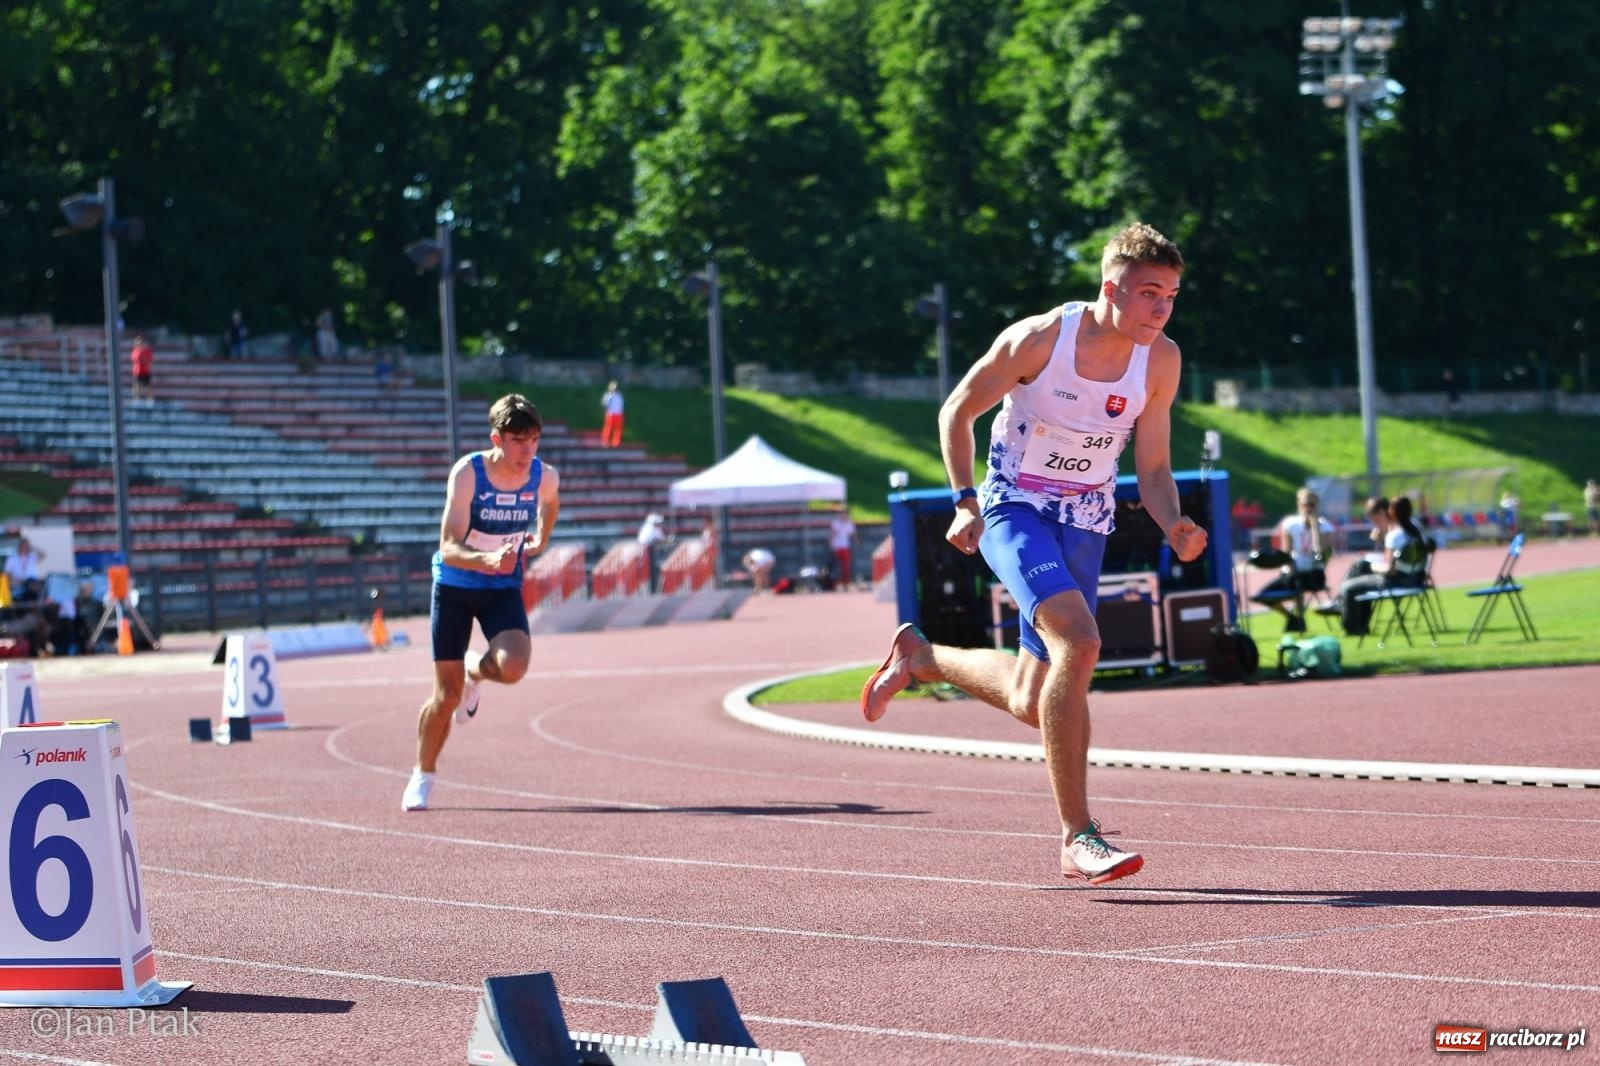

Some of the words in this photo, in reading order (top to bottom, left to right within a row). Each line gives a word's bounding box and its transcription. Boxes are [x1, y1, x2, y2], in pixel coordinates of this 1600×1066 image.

[1082, 436, 1113, 449] 349
[1044, 451, 1092, 472] ŽIGO
[480, 508, 529, 521] CROATIA
[229, 657, 239, 708] 3
[250, 655, 274, 708] 3
[35, 747, 87, 766] polanik
[9, 778, 94, 942] 6
[116, 774, 142, 935] 6
